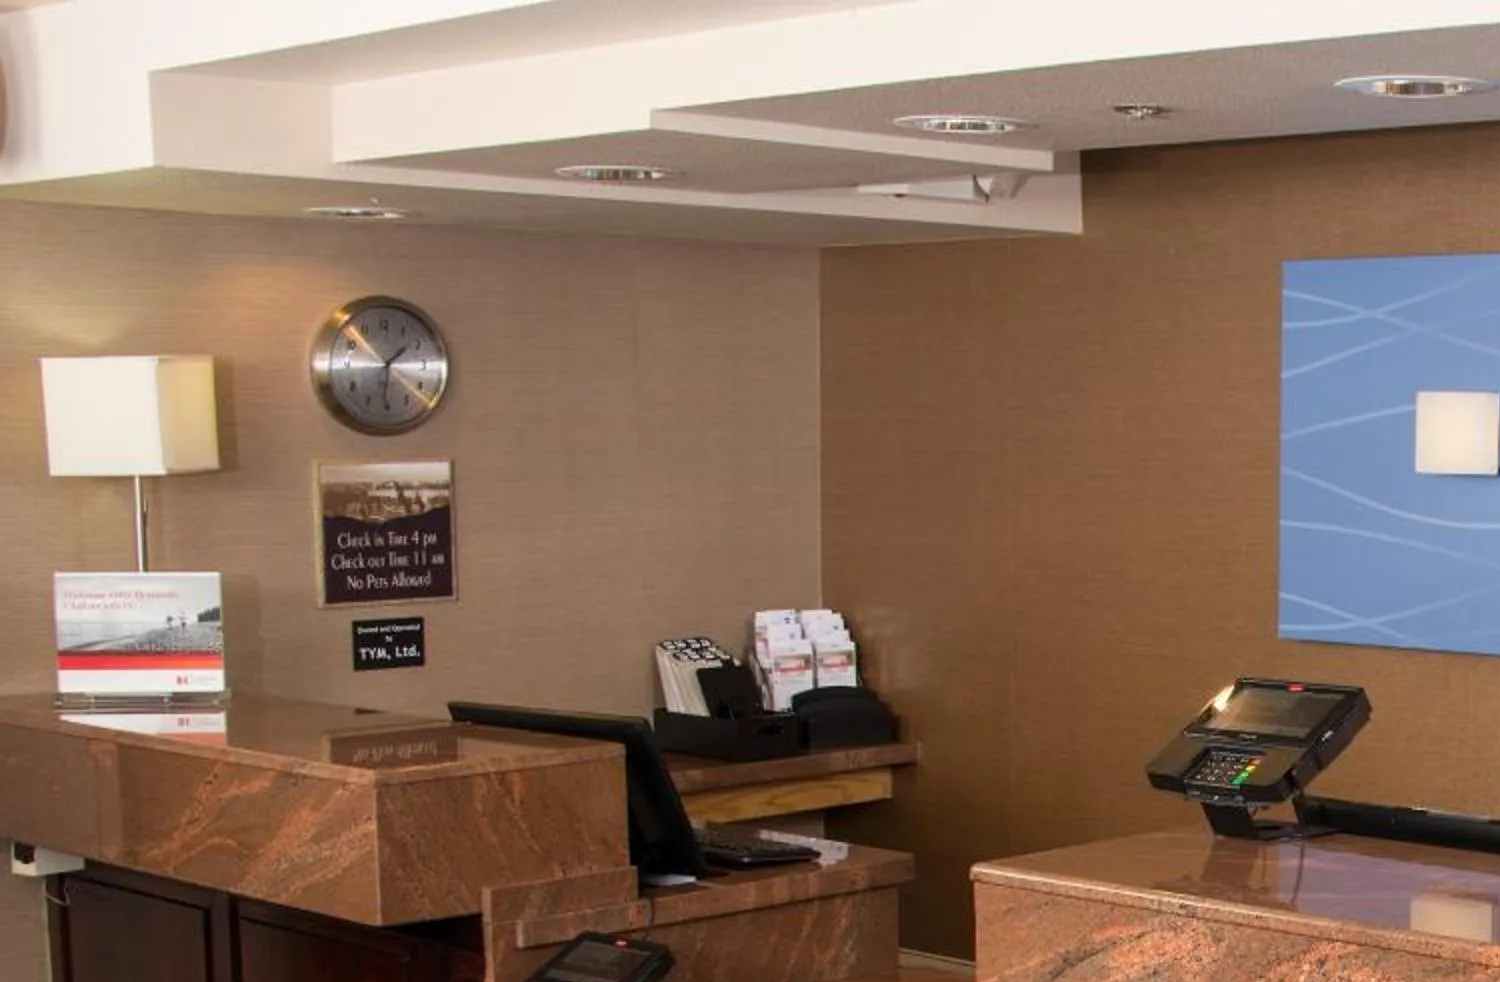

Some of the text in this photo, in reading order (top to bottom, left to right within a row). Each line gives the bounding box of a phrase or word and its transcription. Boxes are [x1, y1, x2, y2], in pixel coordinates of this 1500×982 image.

[337, 530, 371, 549] Check
[411, 530, 420, 545] 4
[331, 551, 366, 570] Check
[413, 550, 427, 566] 11
[347, 574, 364, 590] No
[395, 644, 421, 658] Ltd.
